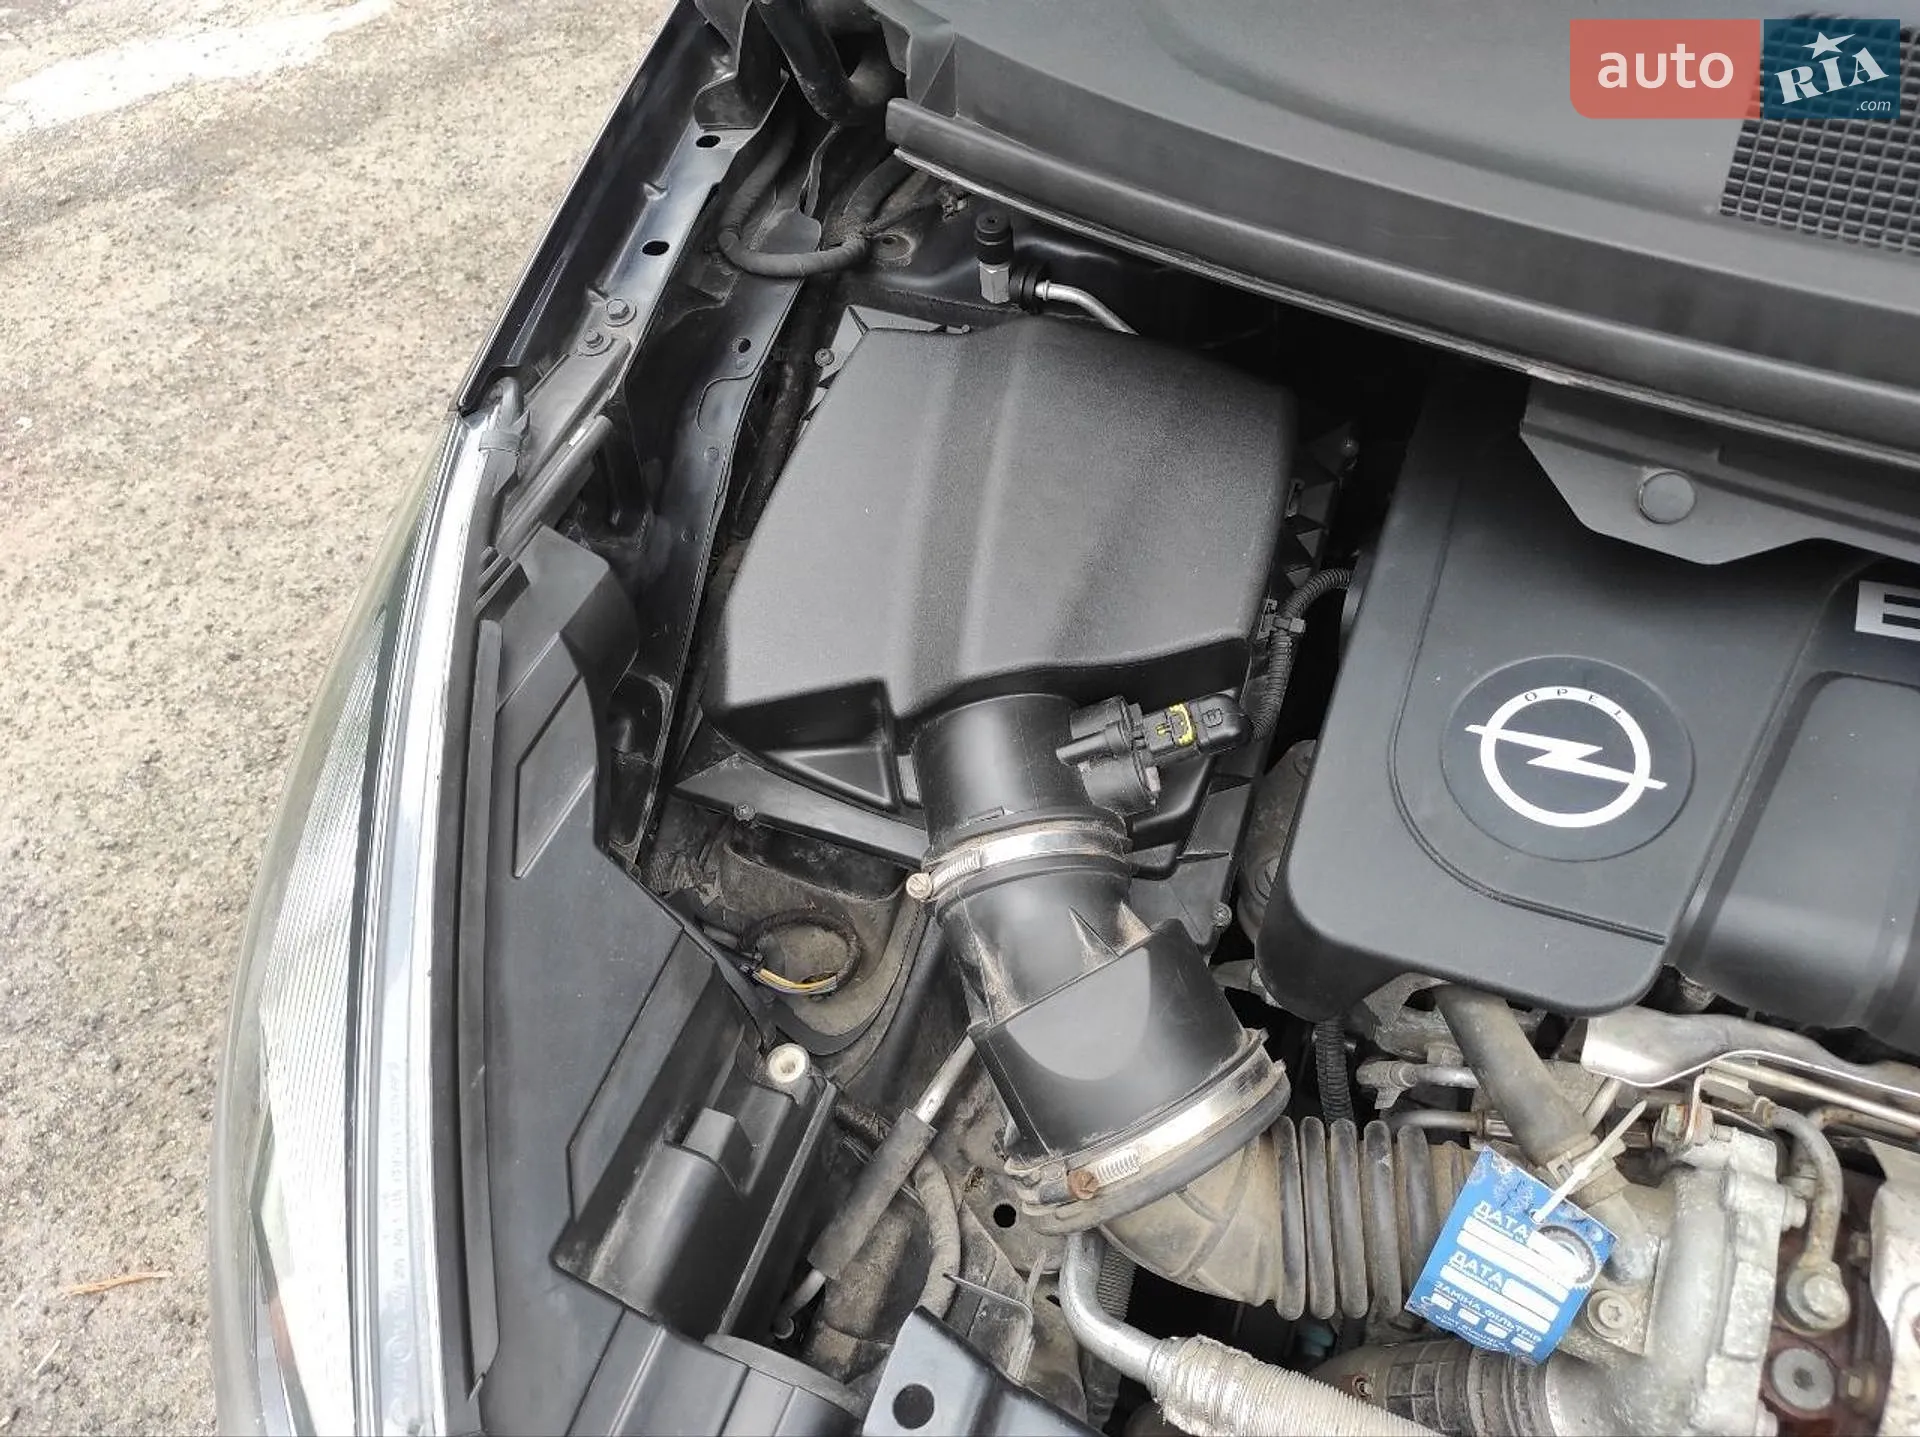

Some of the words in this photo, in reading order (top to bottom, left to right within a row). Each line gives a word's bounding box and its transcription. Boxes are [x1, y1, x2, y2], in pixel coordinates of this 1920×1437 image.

[1525, 688, 1621, 717] OPEL
[1474, 1200, 1528, 1240] ДАТА
[1449, 1251, 1504, 1286] ДАТА
